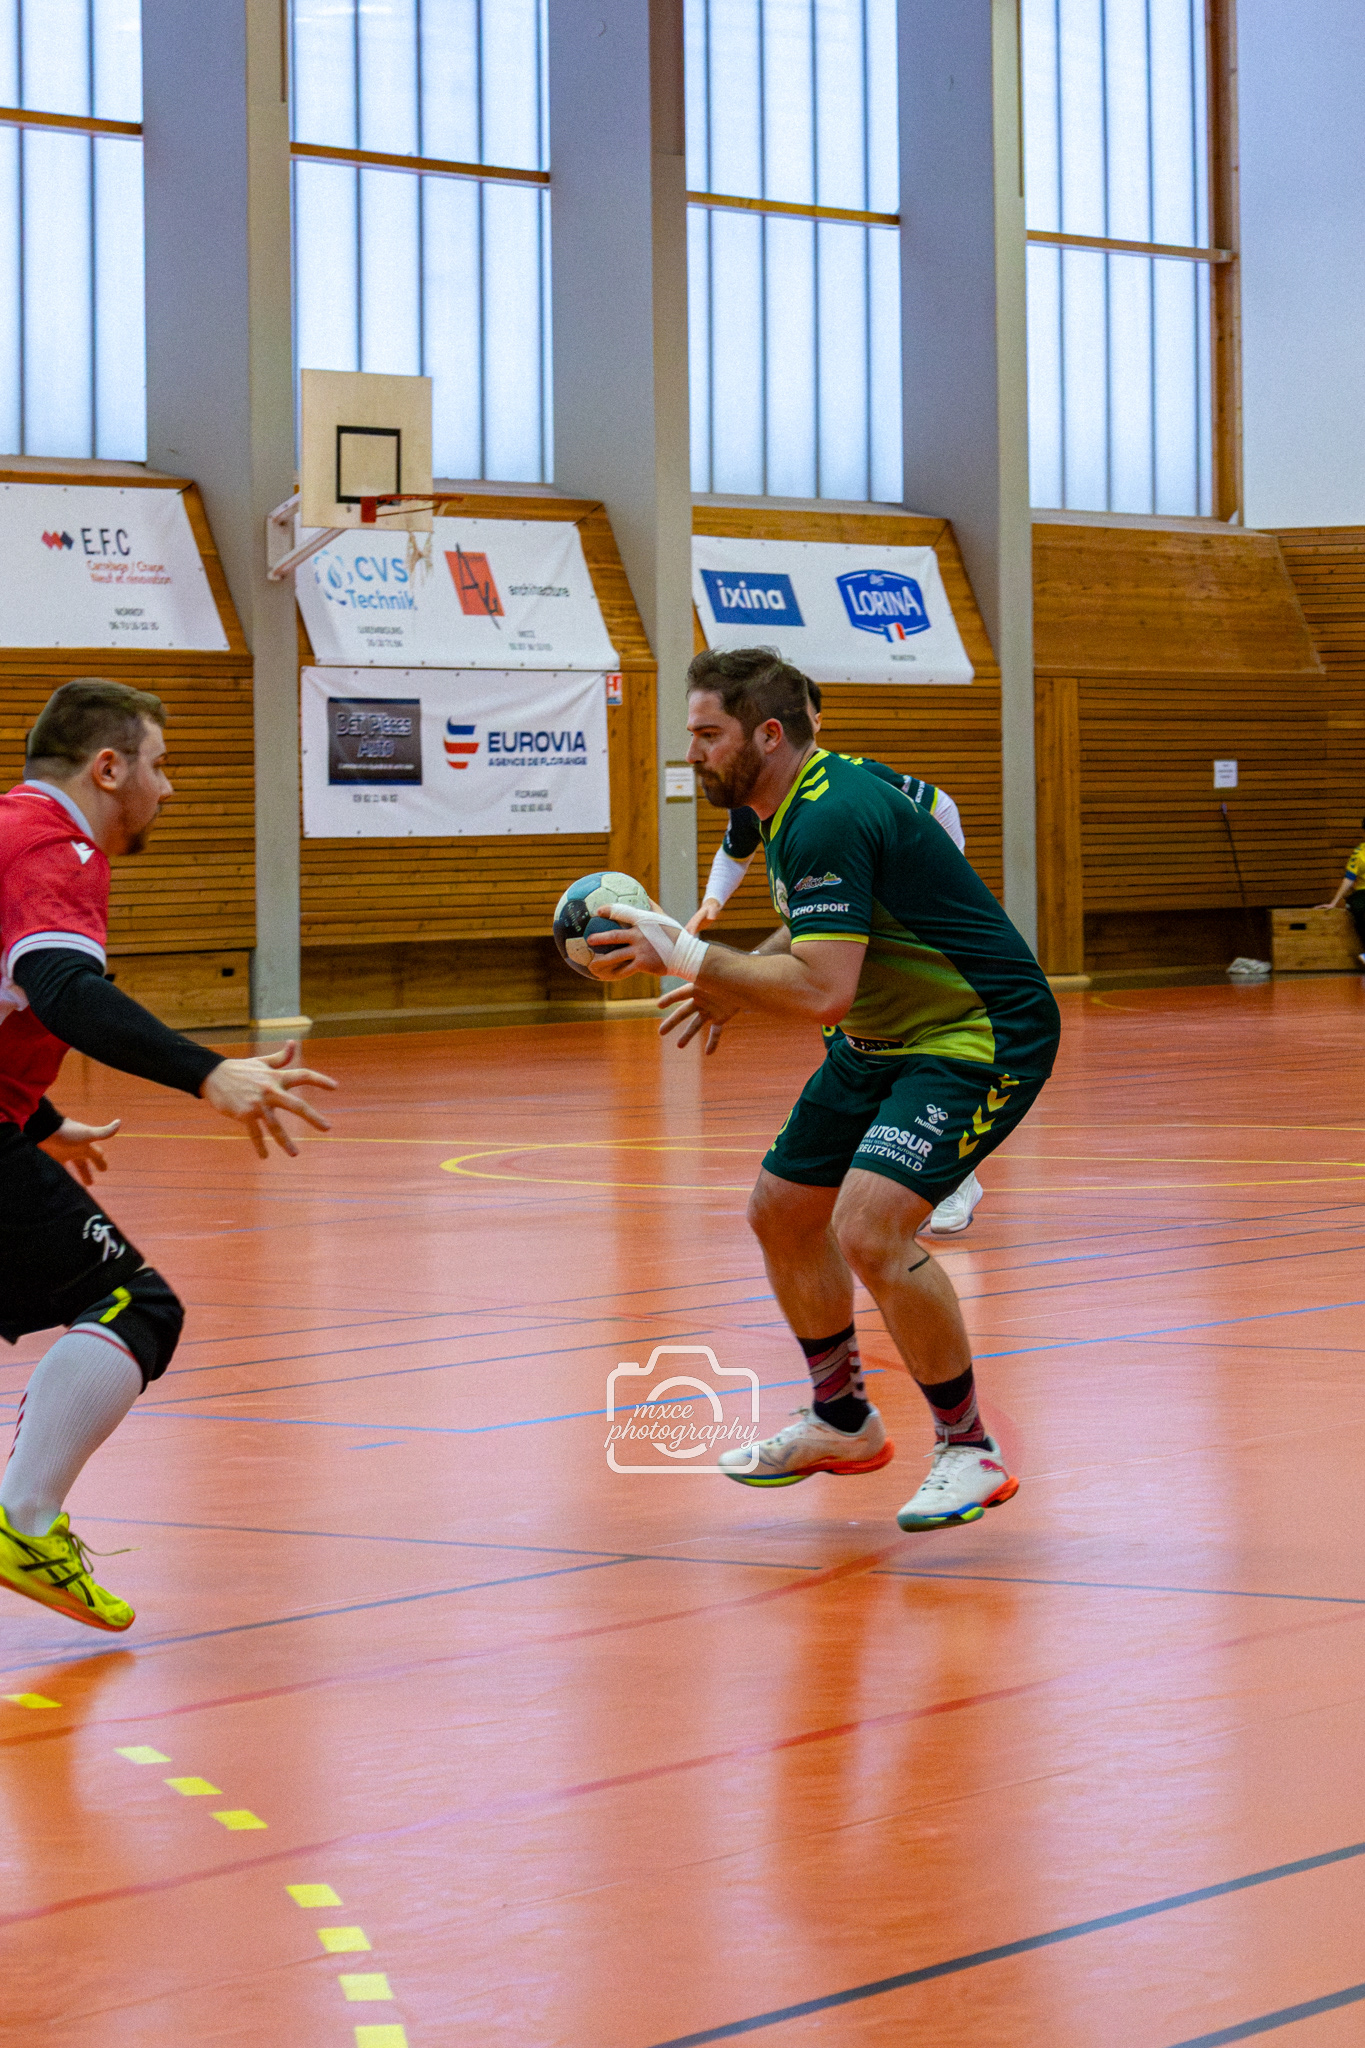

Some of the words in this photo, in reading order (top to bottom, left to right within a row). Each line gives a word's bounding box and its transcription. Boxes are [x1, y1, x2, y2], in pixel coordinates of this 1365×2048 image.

[81, 527, 131, 556] E.F.C
[354, 556, 409, 583] CVS
[716, 579, 787, 611] ixina
[846, 583, 923, 617] LORINA
[488, 731, 587, 753] EUROVIA
[914, 1115, 944, 1137] hummel
